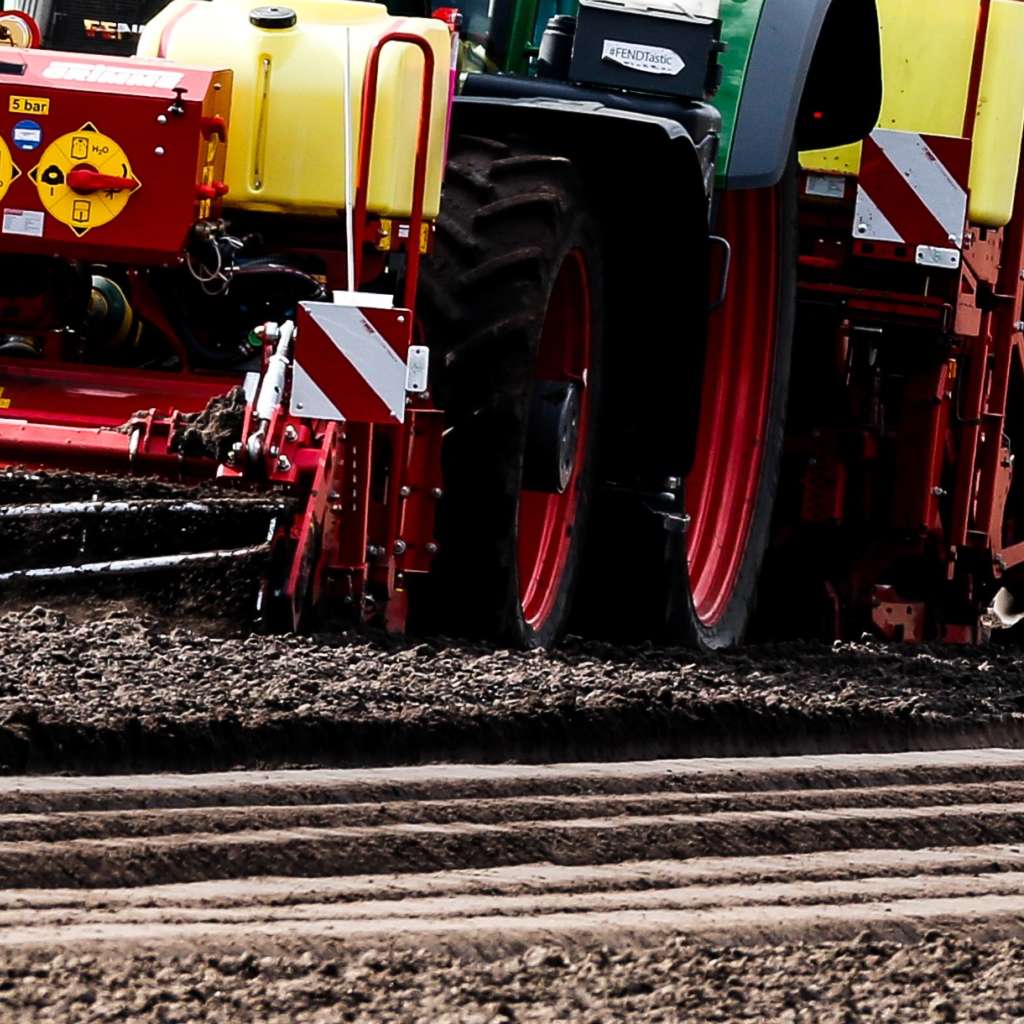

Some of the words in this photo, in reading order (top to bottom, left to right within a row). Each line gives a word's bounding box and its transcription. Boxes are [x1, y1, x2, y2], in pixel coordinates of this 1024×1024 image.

[609, 47, 673, 66] #FENDTastic
[12, 98, 20, 110] 5
[24, 99, 47, 112] bar
